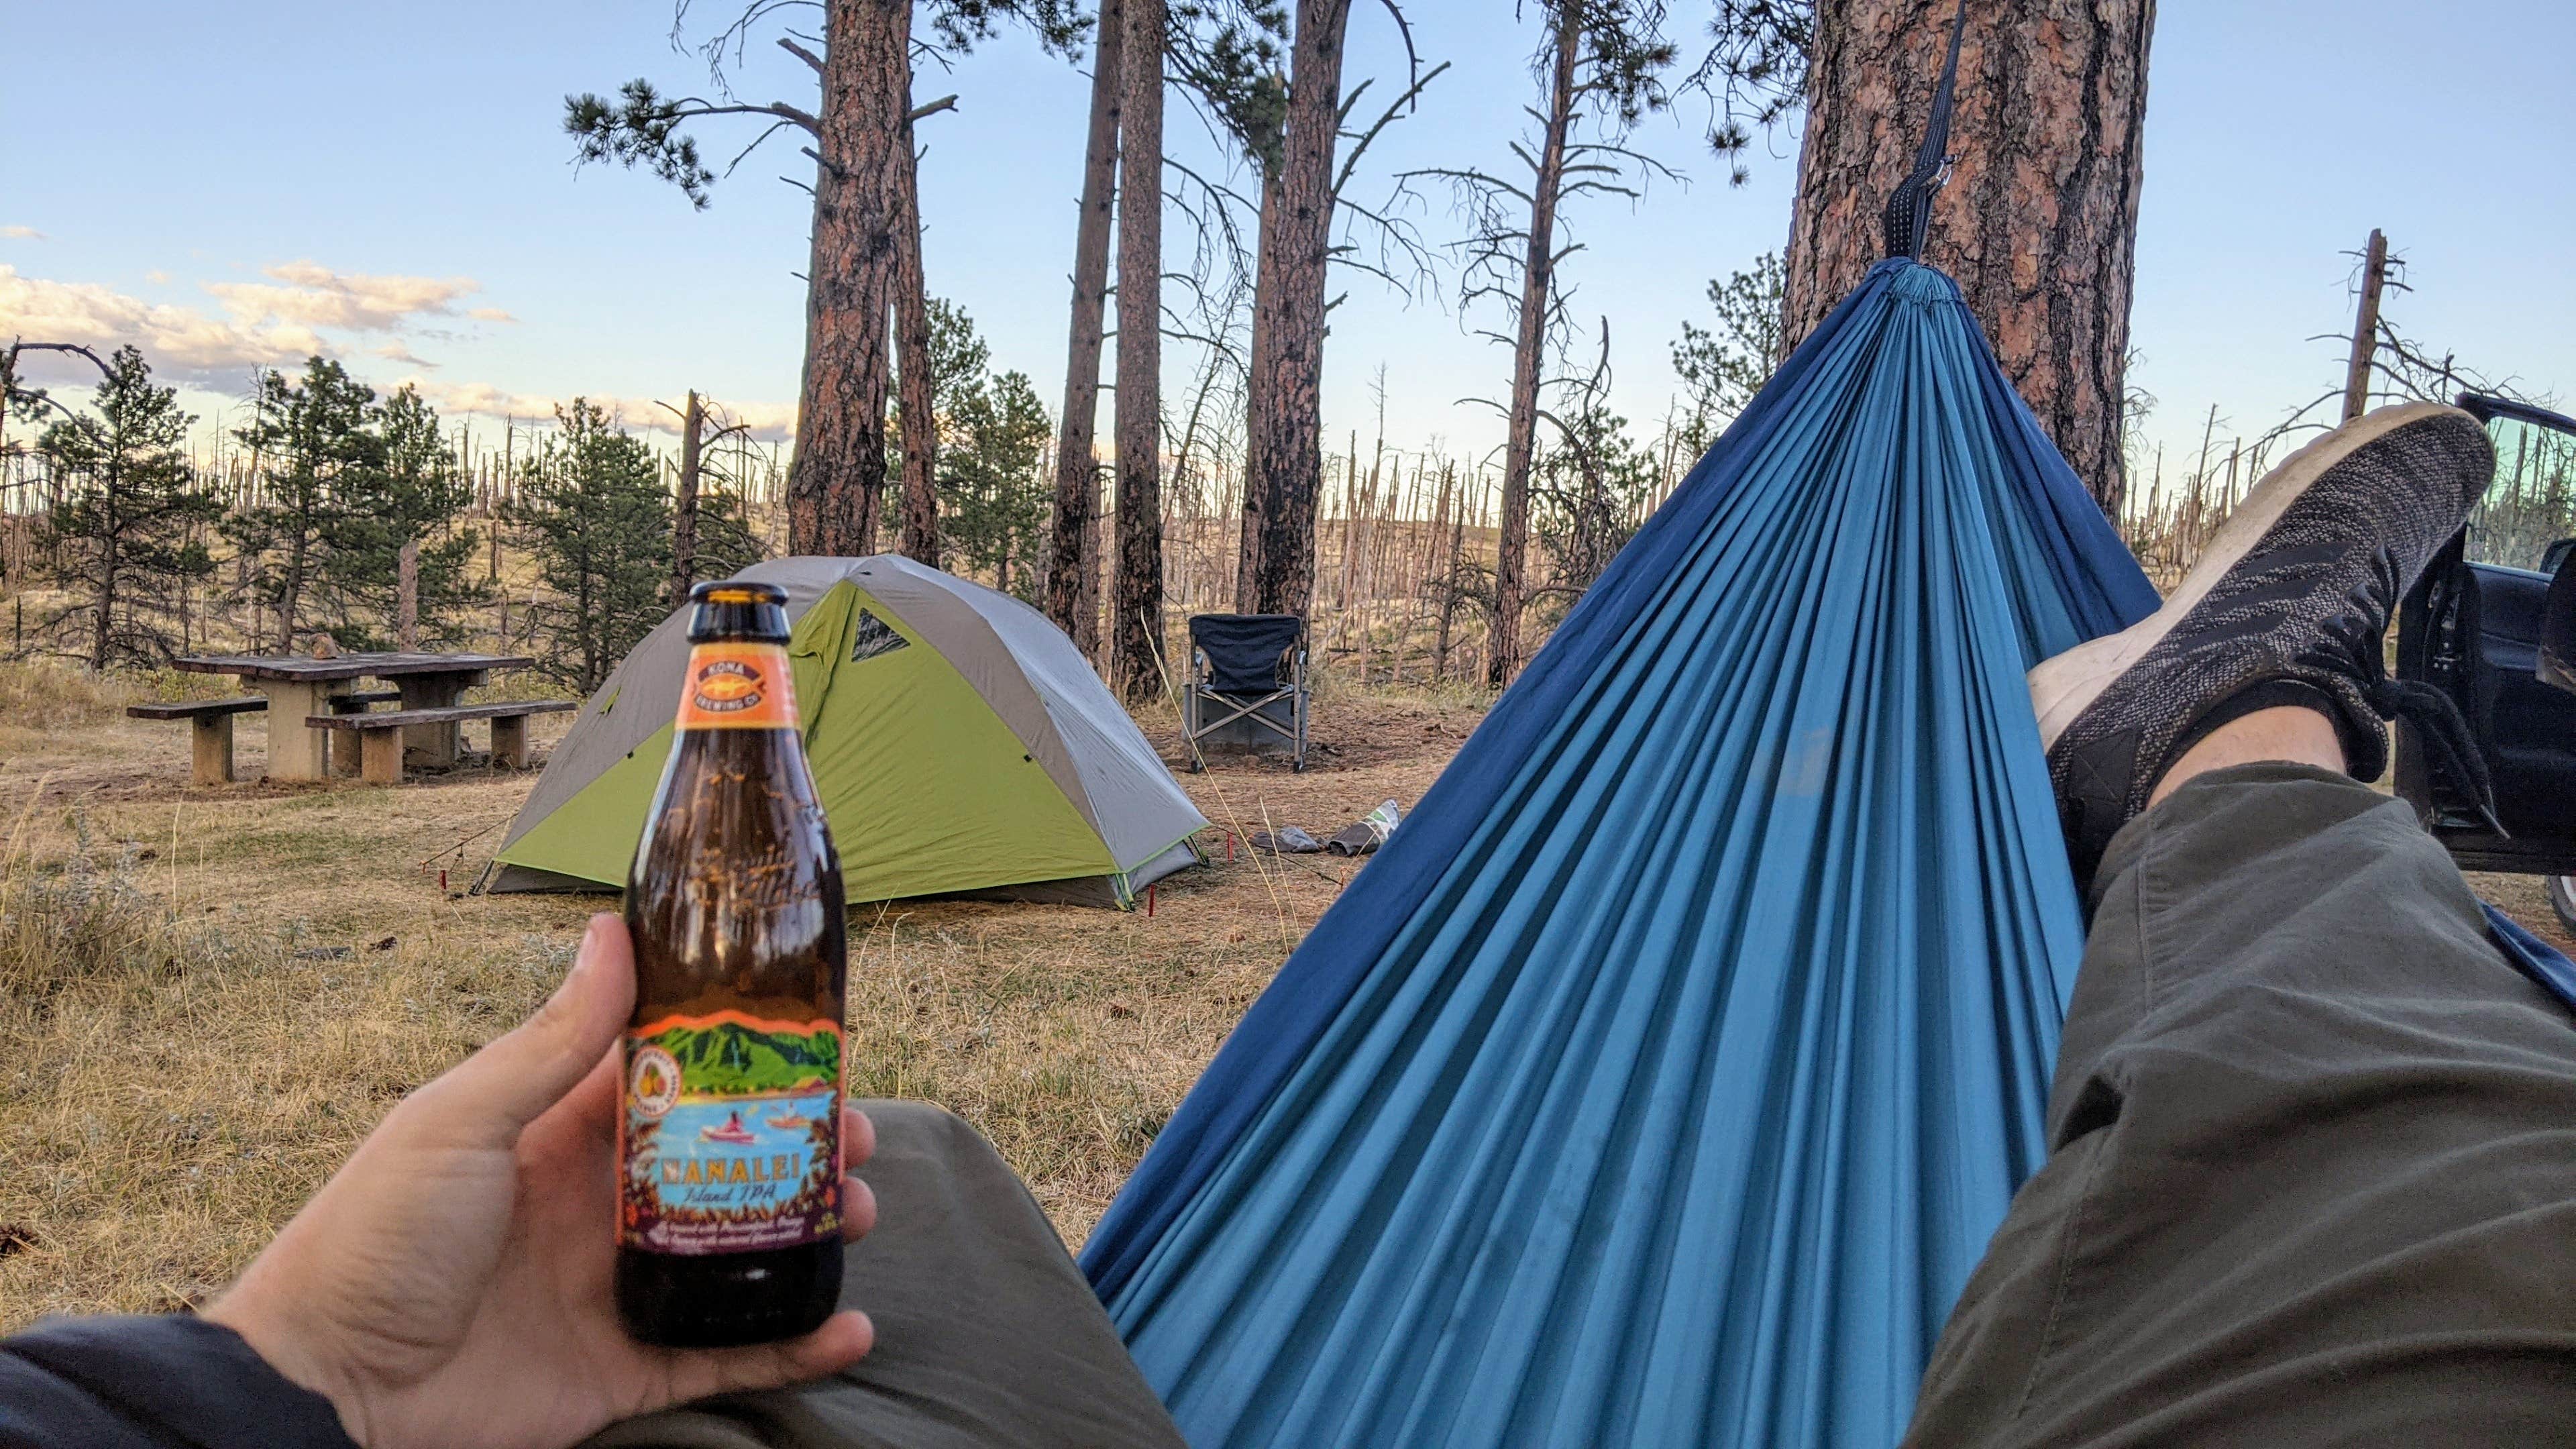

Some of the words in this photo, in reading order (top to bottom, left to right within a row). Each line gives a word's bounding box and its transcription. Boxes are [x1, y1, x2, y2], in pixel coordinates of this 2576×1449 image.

[708, 661, 744, 675] KONA
[697, 694, 743, 710] BREWING
[661, 1153, 800, 1184] HANALEI
[684, 1185, 732, 1202] Island
[740, 1184, 776, 1201] IPA
